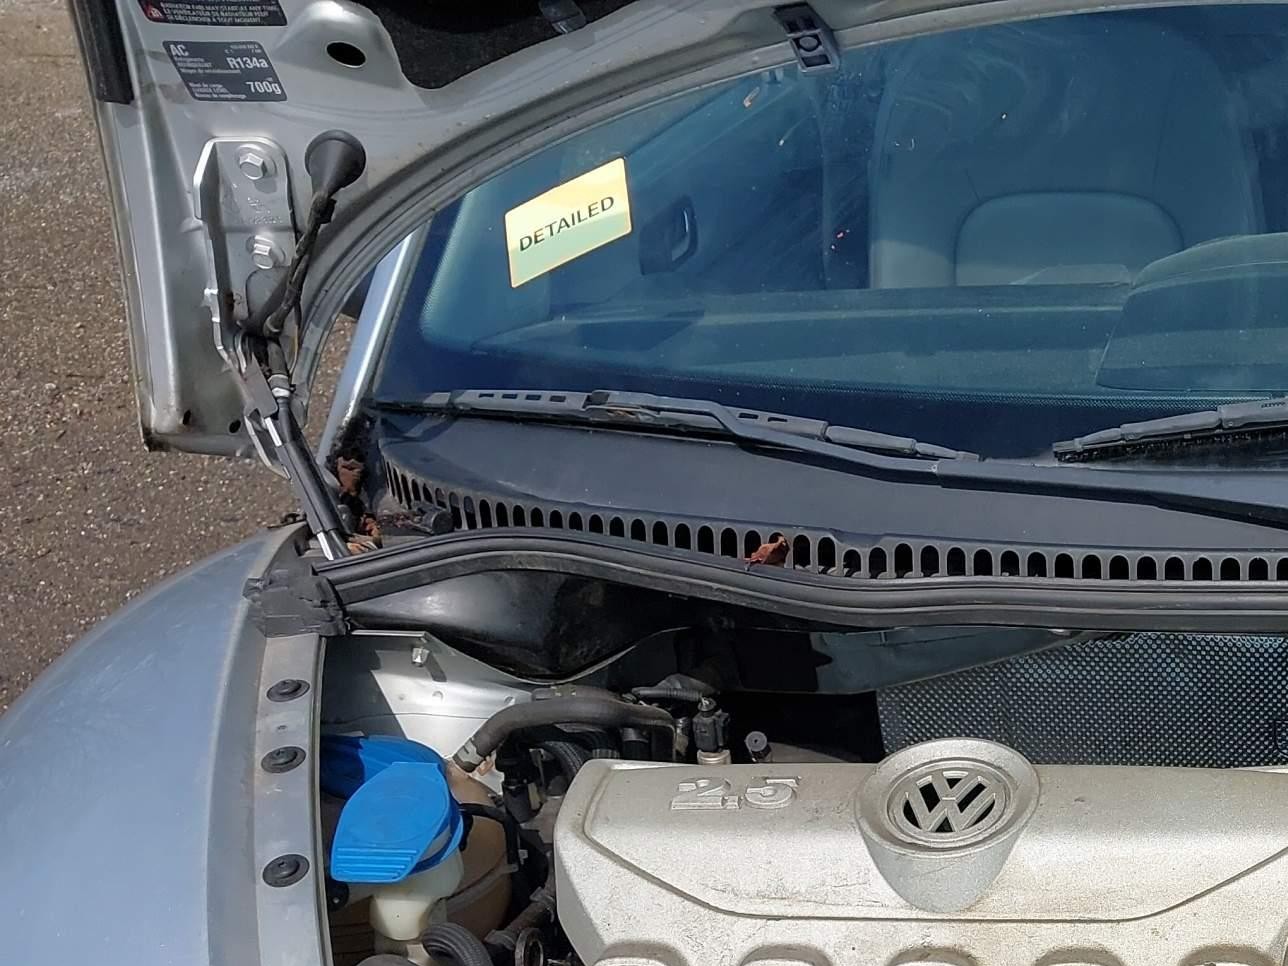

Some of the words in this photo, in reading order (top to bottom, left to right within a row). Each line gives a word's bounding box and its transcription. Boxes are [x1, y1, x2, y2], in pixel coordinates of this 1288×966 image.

[170, 44, 189, 57] AC
[226, 57, 269, 69] R134a
[245, 81, 282, 95] 700g
[519, 196, 615, 252] DETAILED
[670, 776, 801, 811] 2.5
